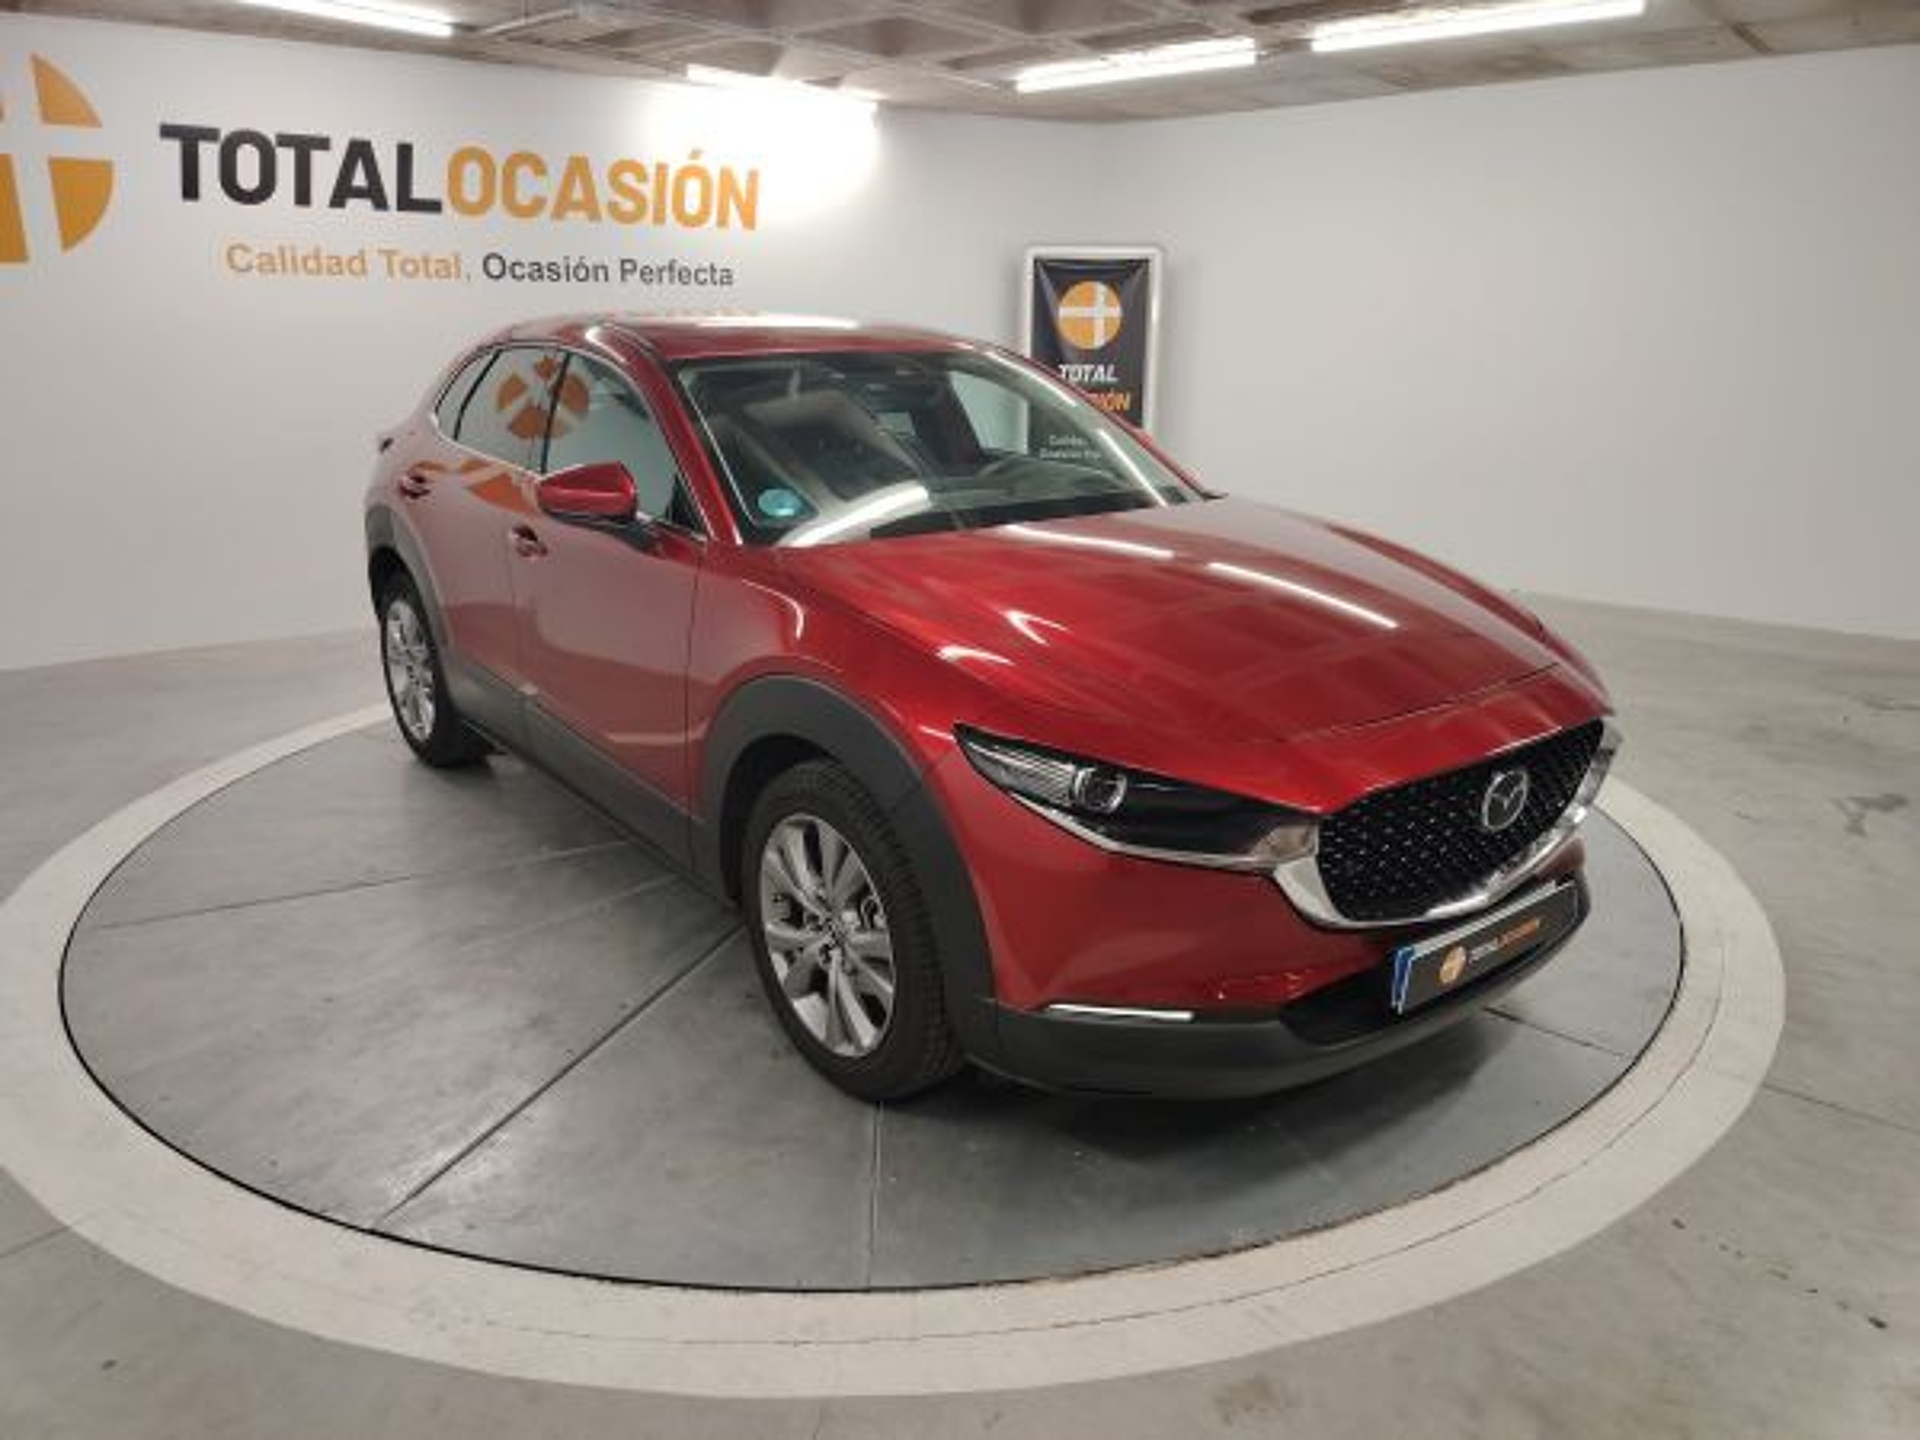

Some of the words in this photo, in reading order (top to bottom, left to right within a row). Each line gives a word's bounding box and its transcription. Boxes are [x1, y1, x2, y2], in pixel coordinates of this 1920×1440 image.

[226, 243, 368, 277] Calidad
[482, 251, 610, 283] Ocasión
[619, 258, 734, 287] Perfecta
[1058, 363, 1119, 382] TOTAL
